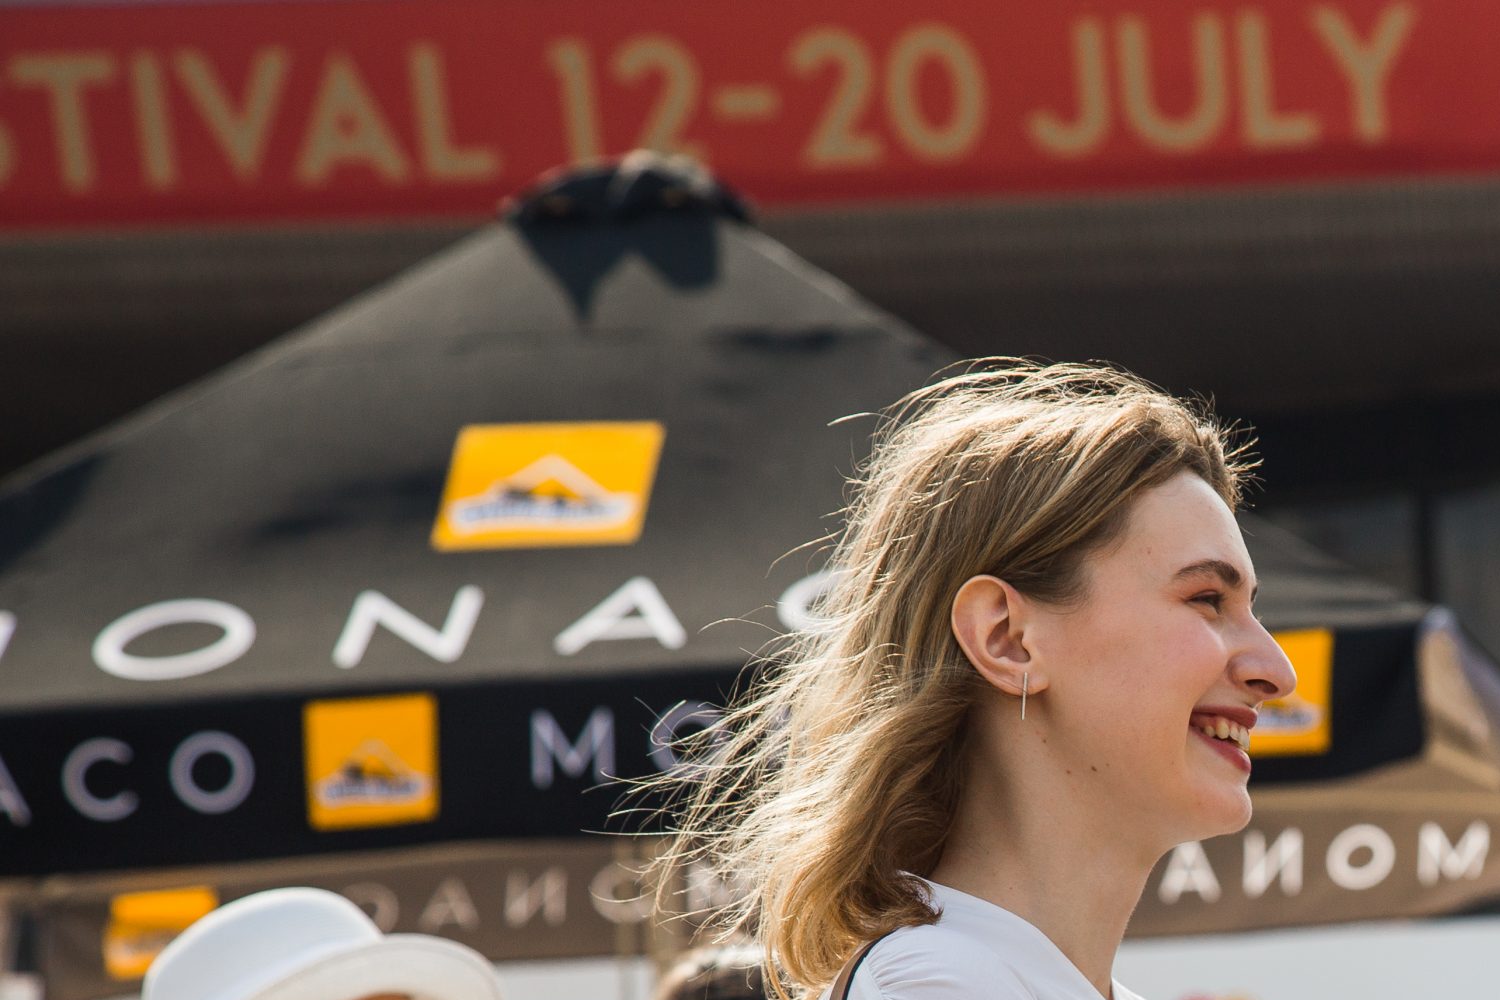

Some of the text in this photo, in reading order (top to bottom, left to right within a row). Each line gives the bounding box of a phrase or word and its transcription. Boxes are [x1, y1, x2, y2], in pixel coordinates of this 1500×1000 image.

[0, 3, 1414, 192] TIVAL 12-20 JULY
